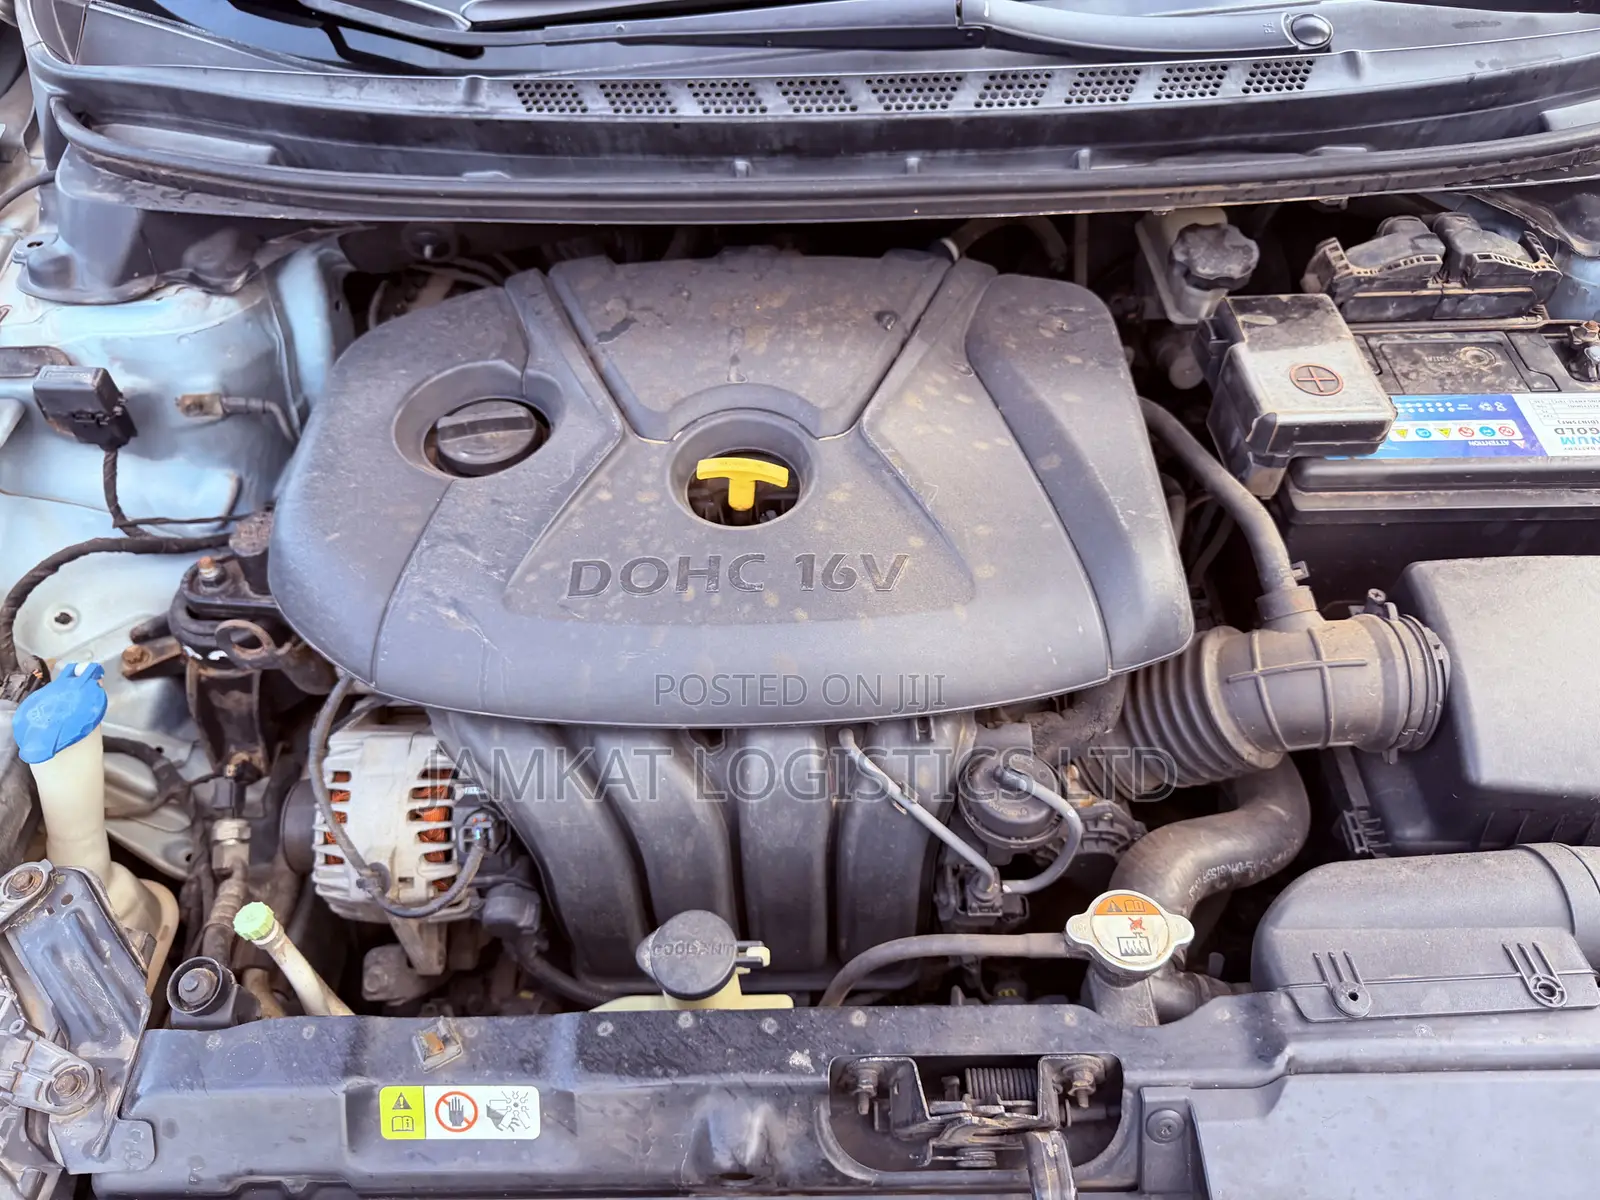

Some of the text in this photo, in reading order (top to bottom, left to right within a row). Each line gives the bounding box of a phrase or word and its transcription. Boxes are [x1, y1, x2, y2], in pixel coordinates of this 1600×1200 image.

[1554, 427, 1600, 435] GOLD
[567, 553, 909, 599] DOHC 16V
[653, 942, 735, 956] COOLANT
